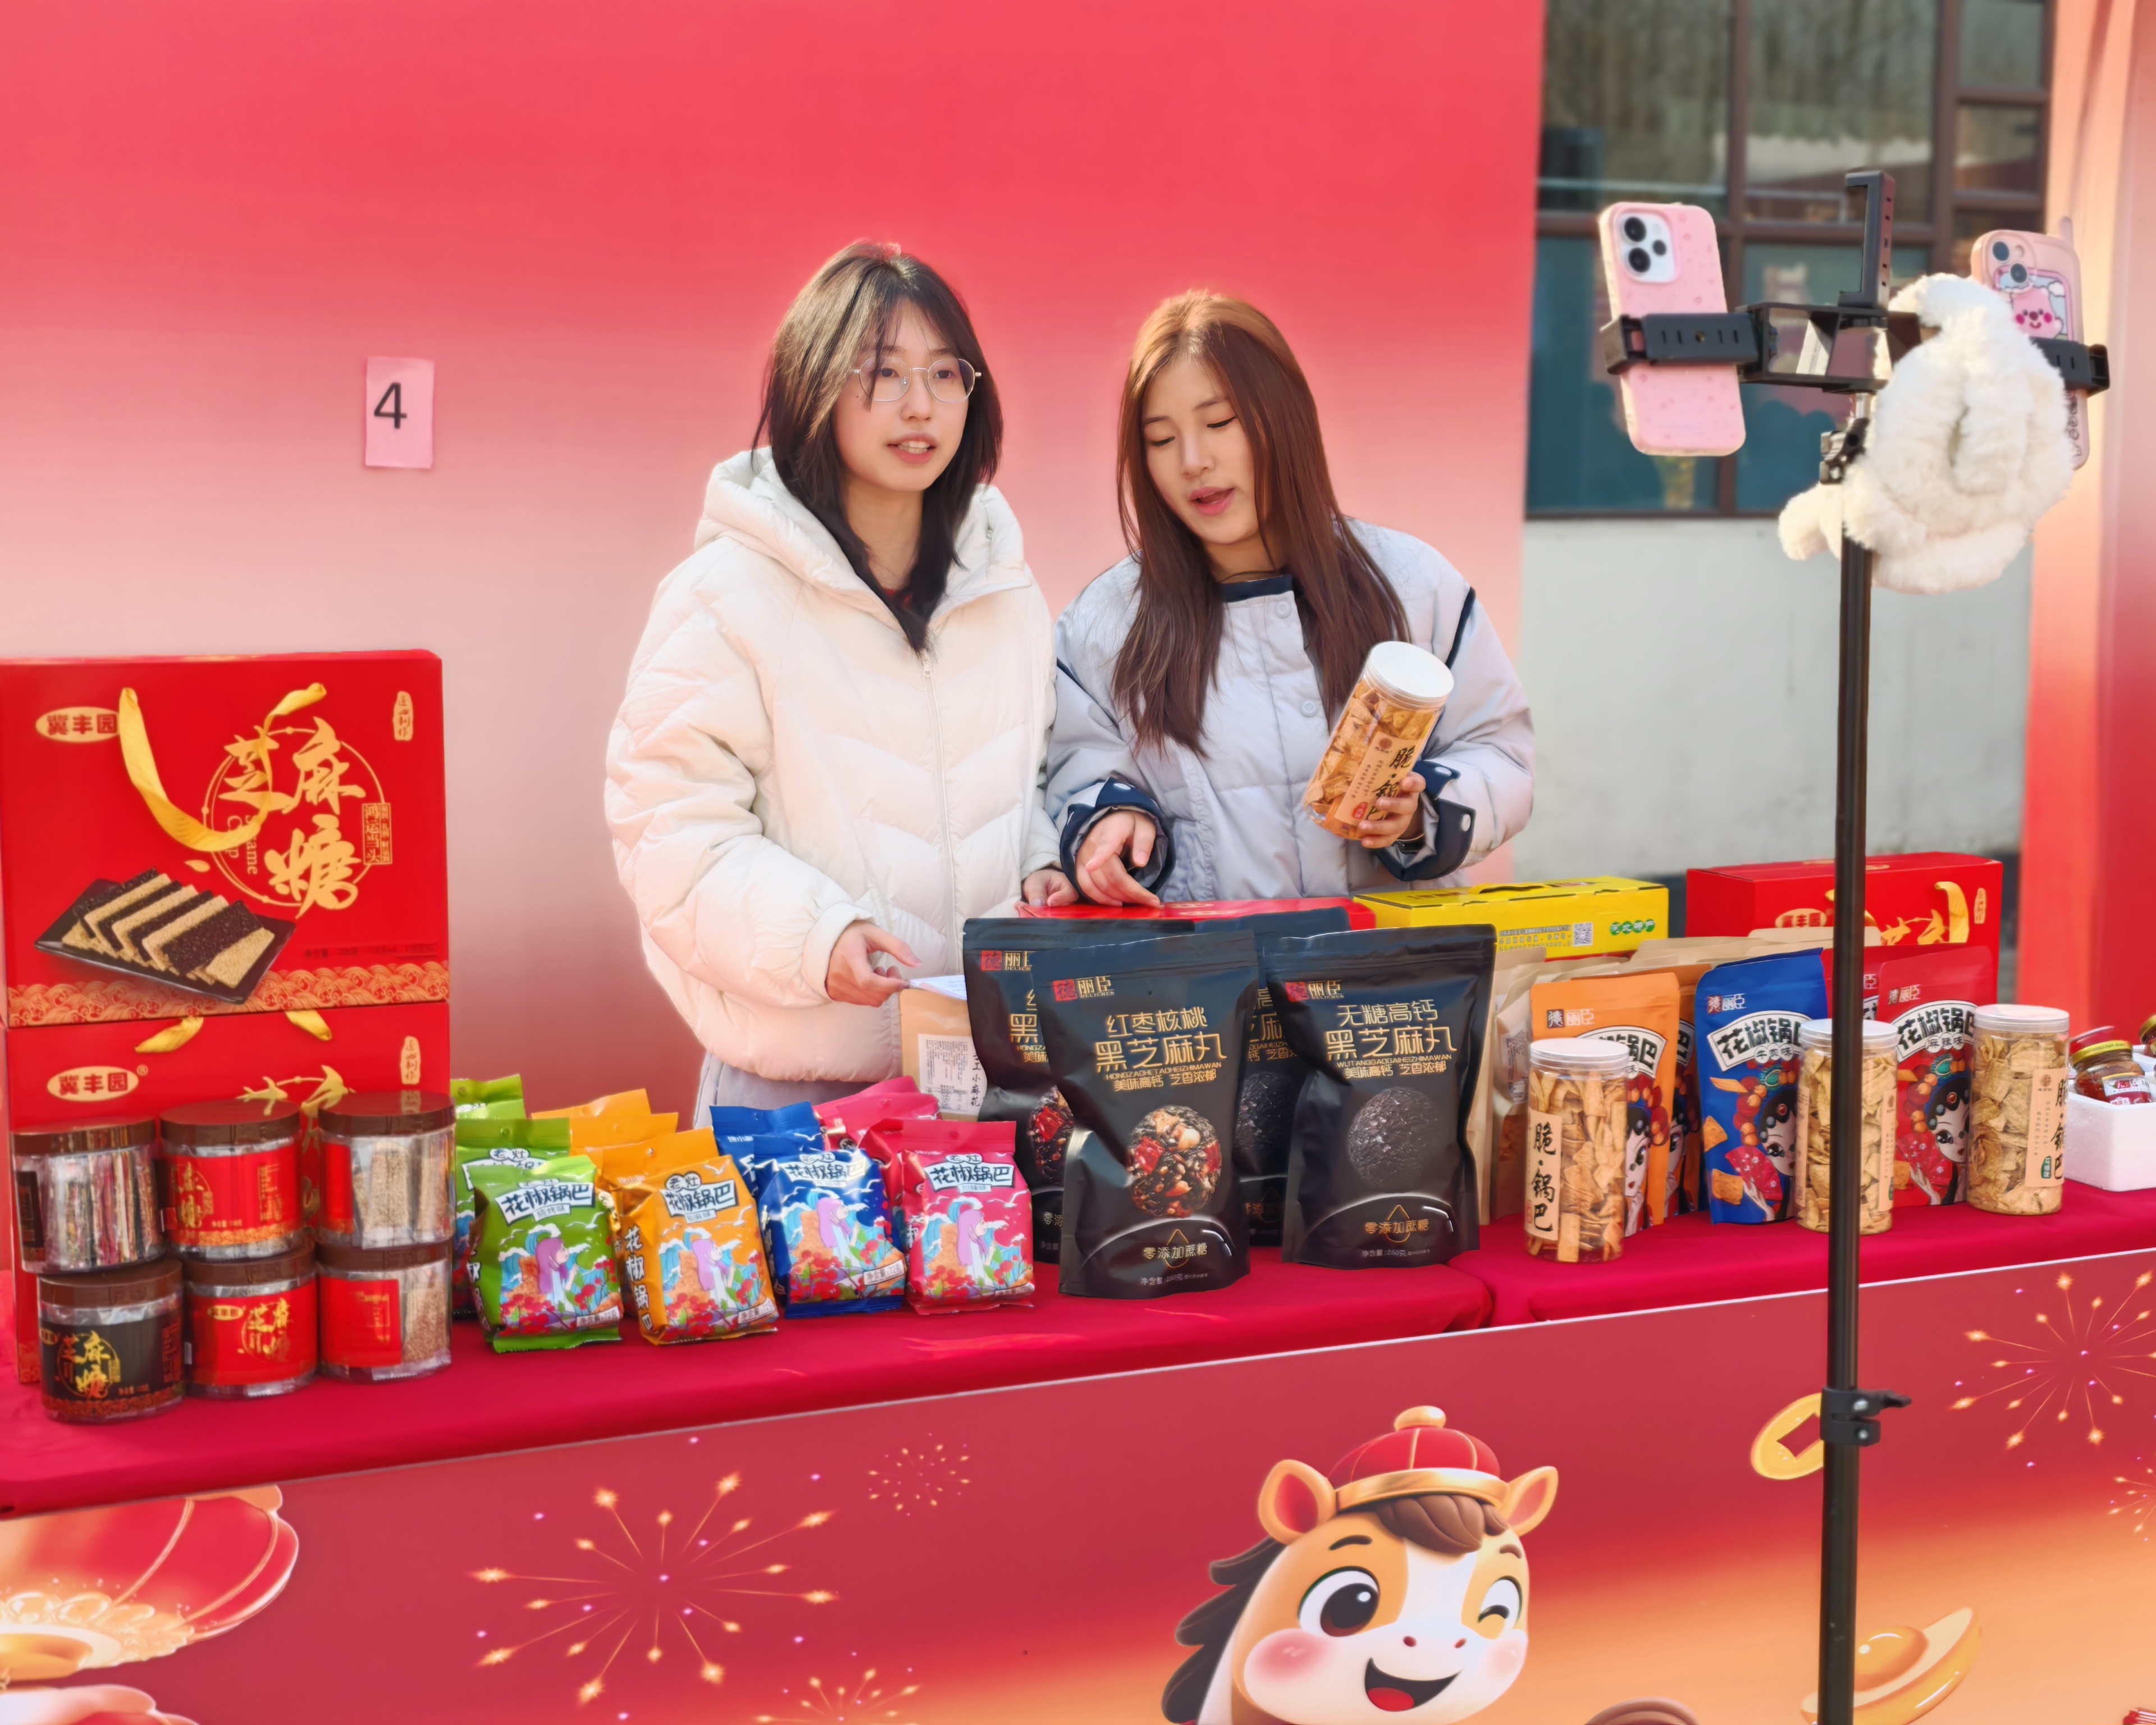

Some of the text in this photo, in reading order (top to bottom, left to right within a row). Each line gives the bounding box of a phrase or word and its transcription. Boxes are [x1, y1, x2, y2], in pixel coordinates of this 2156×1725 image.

[374, 382, 407, 429] 4
[1106, 1006, 1208, 1038] 红枣核桃
[1337, 999, 1438, 1026] 无糖高钙
[1095, 1030, 1227, 1073] 黑芝麻丸
[1326, 1023, 1457, 1061] 黑芝麻丸
[1716, 1017, 1802, 1060] 花椒锅
[1114, 1069, 1217, 1092] 美味高钙 芝香浓郁
[1344, 1060, 1447, 1079] 美味高钙 芝香浓郁
[930, 1164, 1012, 1184] 花椒锅巴
[501, 1184, 591, 1215] 花椒锅巴
[665, 1183, 734, 1212] 花椒锅巴
[1143, 1242, 1208, 1259] 零添加蔗糖
